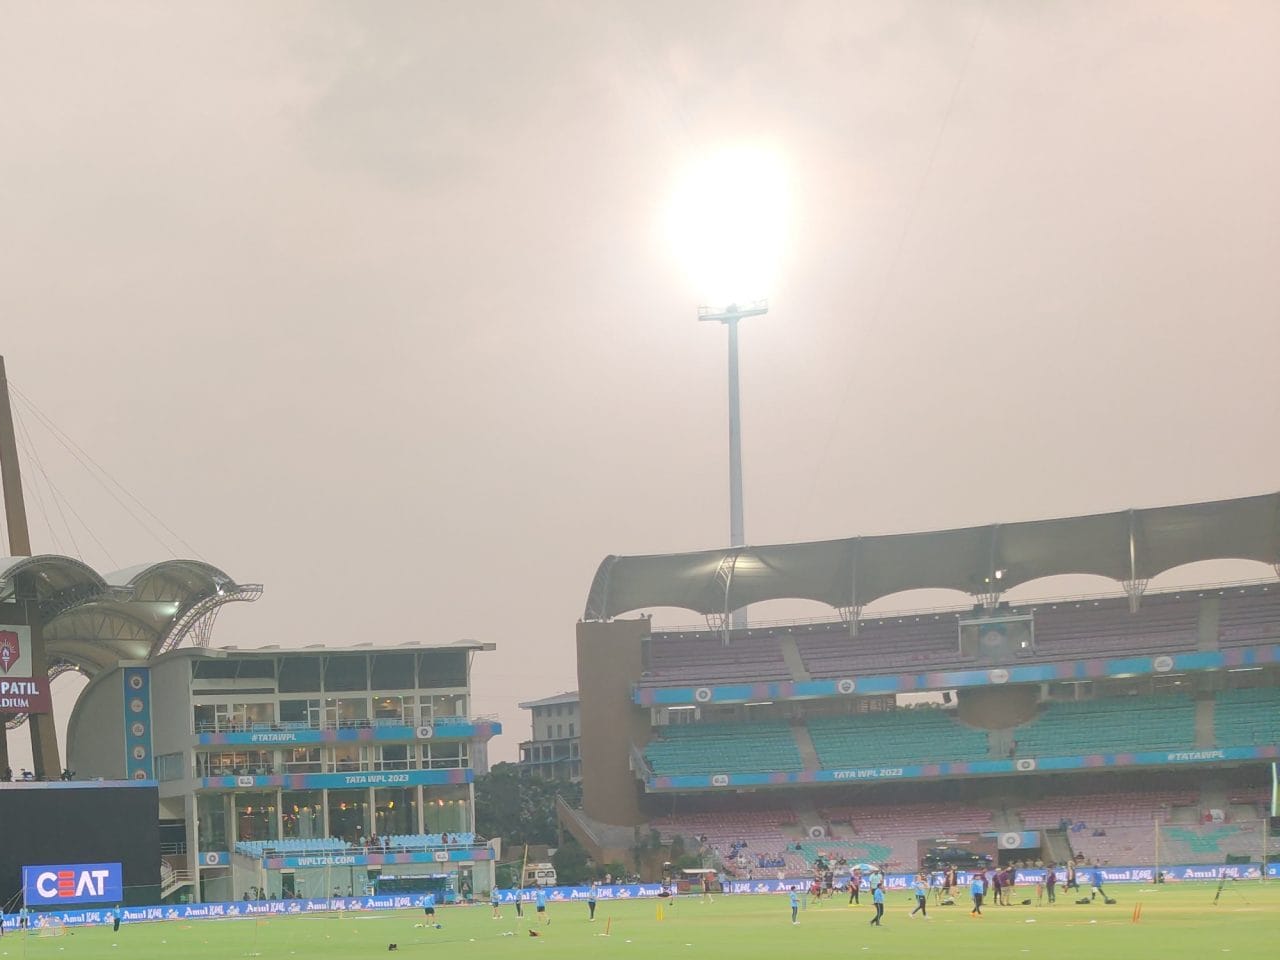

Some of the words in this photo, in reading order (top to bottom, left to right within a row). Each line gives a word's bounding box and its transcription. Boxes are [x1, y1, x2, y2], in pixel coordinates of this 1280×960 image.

[1, 682, 39, 695] PATIL
[252, 733, 296, 742] #TATAWPL
[345, 776, 366, 784] TATA
[368, 775, 387, 783] WPL
[388, 774, 409, 782] 2023
[1184, 868, 1216, 878] Amul
[36, 870, 109, 897] CEAT
[367, 898, 393, 907] Amul
[123, 910, 146, 920] Amul
[185, 907, 208, 916] Amul
[63, 913, 85, 923] Amul
